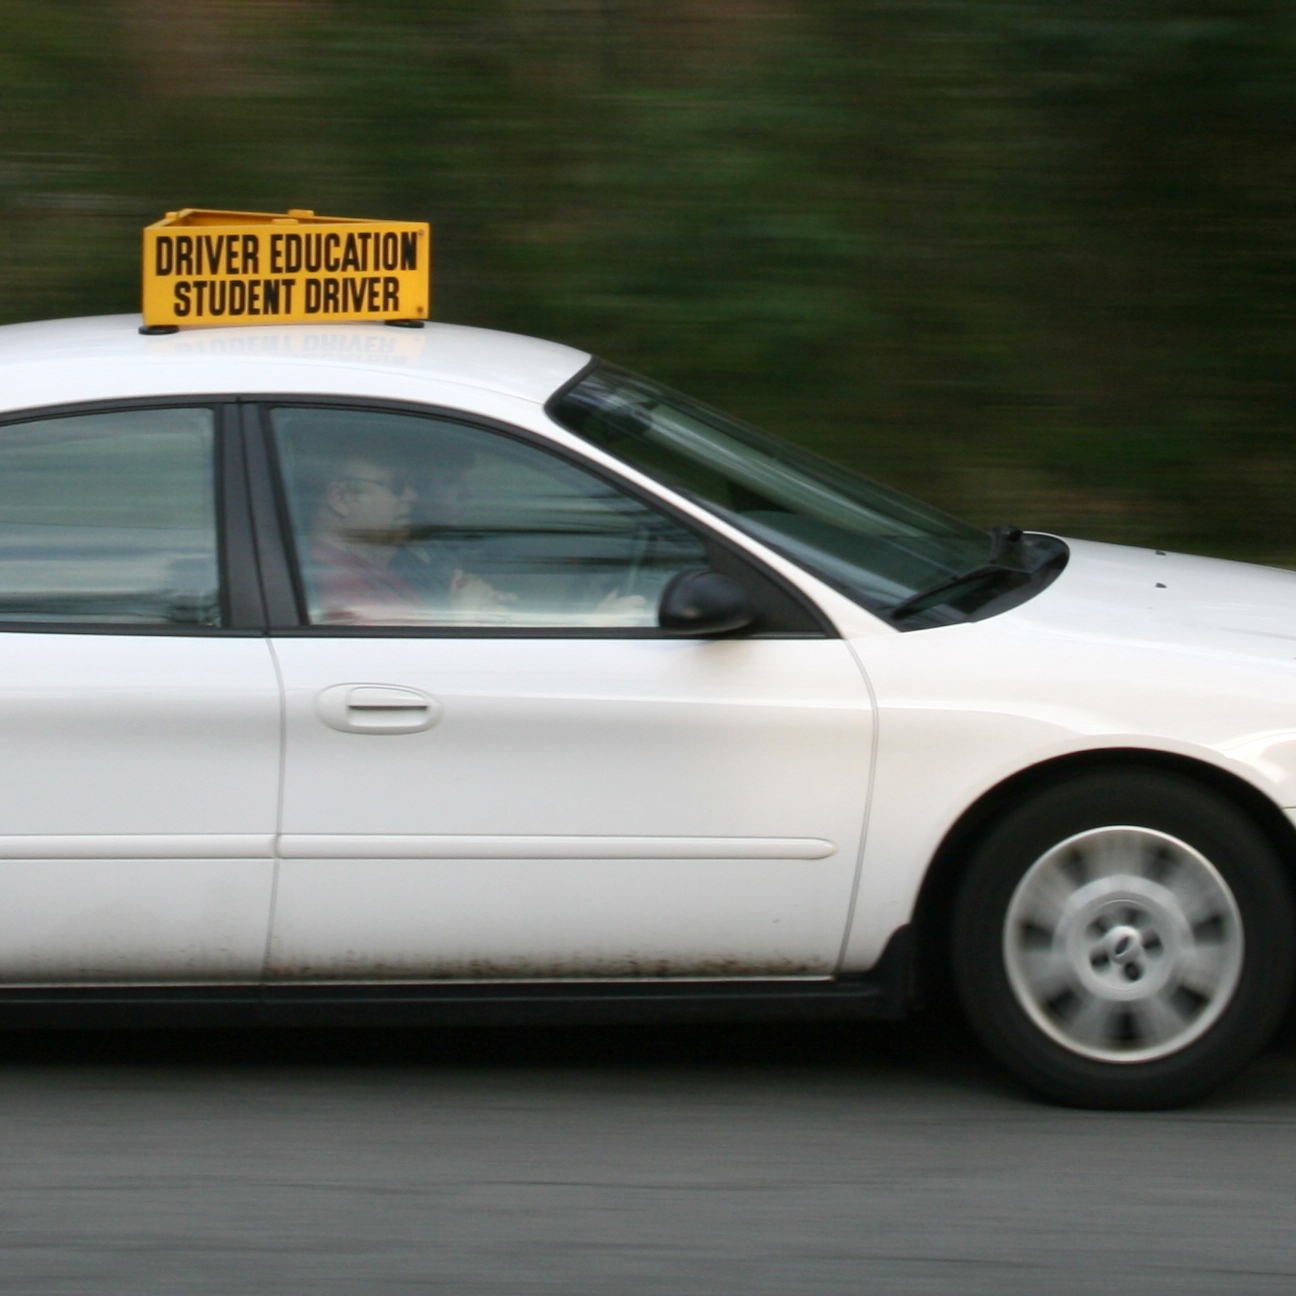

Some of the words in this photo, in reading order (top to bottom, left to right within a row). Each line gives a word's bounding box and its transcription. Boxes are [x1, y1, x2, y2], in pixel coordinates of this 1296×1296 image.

[155, 234, 259, 276] DRIVER
[270, 231, 417, 273] EDUCATION
[174, 279, 296, 316] STUDENT
[305, 277, 400, 314] DRIVER
